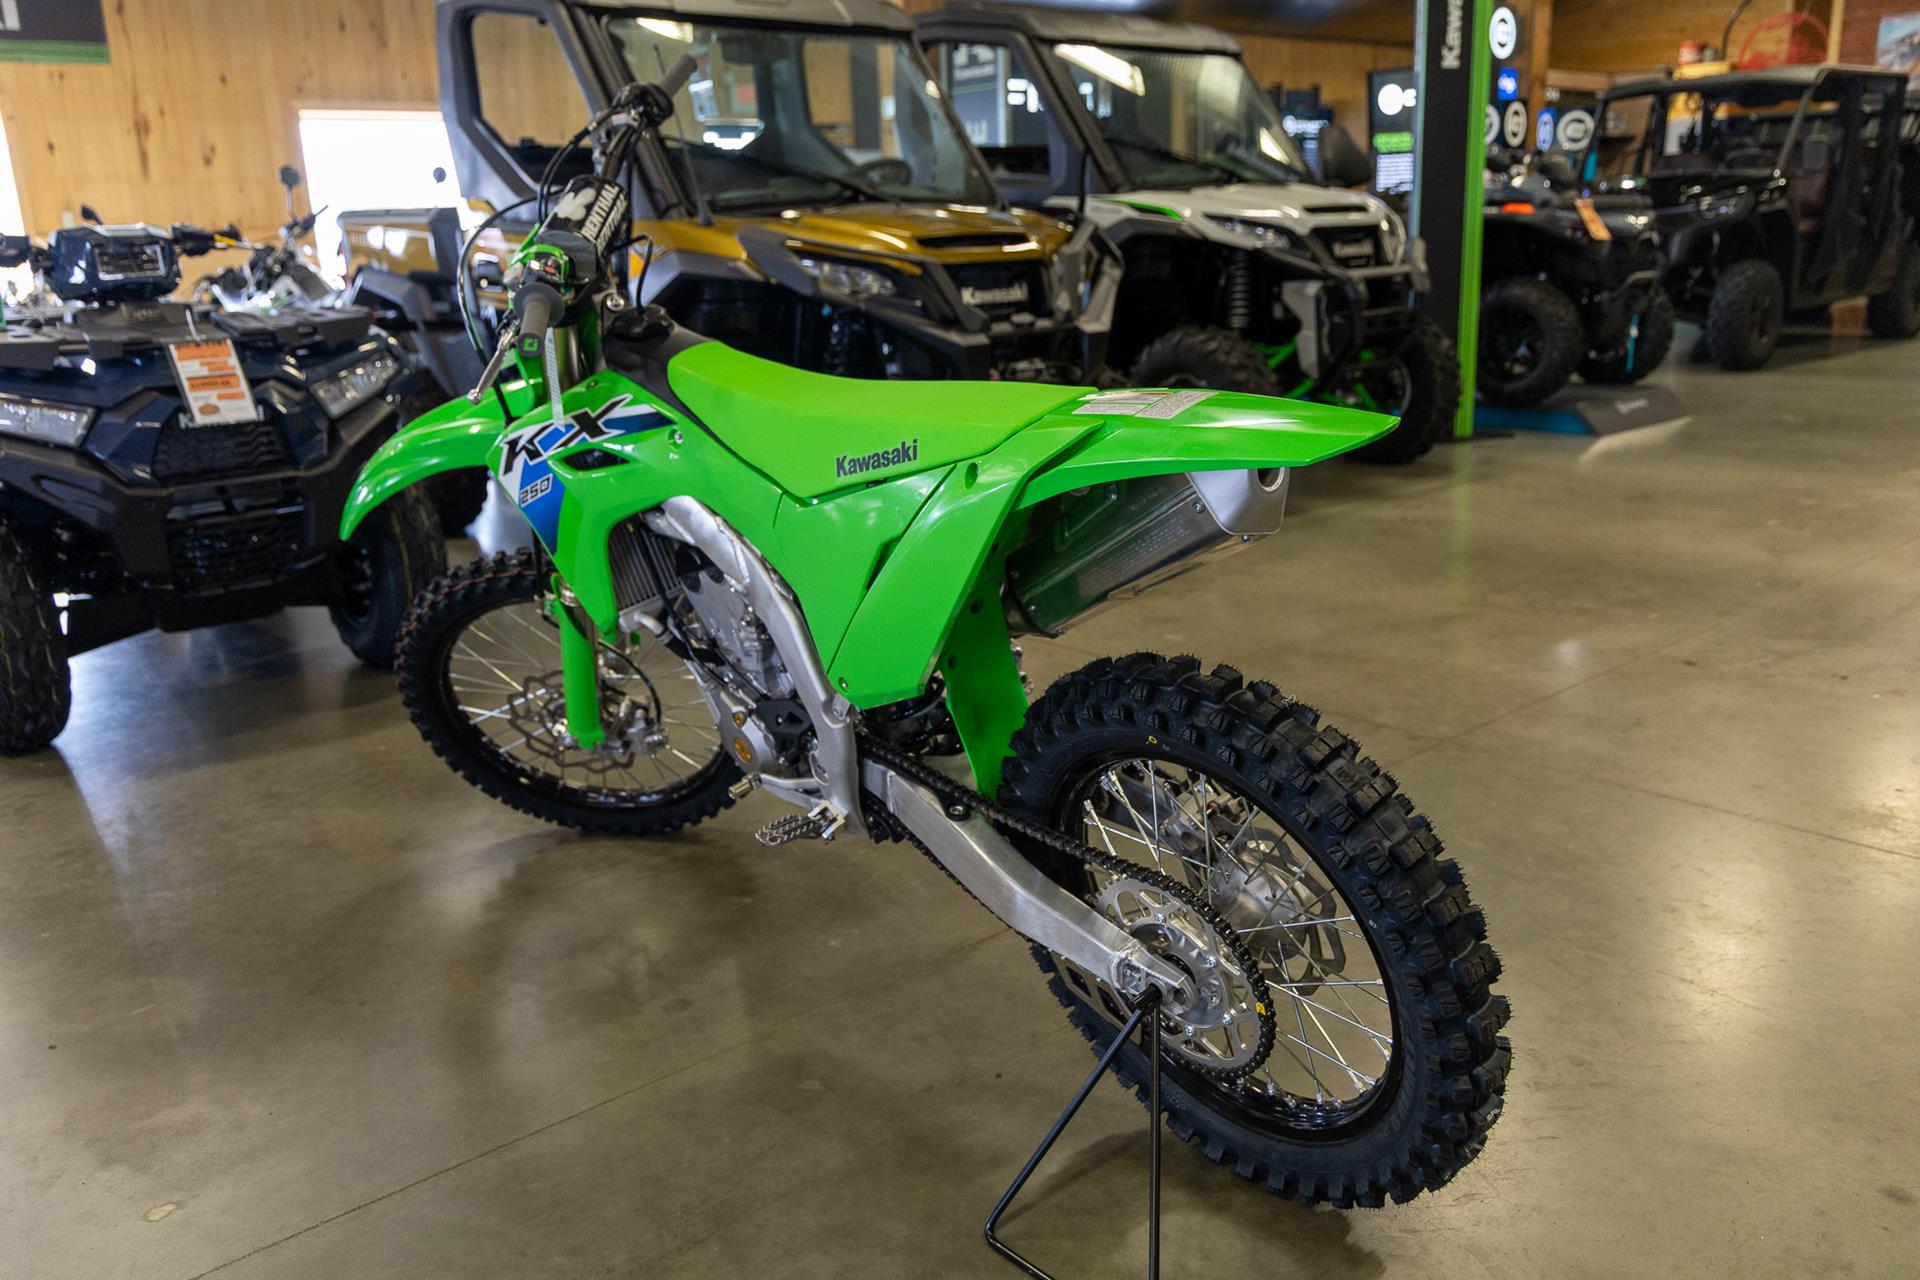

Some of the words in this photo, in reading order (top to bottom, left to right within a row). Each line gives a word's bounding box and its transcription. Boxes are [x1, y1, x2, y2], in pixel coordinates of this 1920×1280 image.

[579, 182, 620, 245] RENTHAL
[502, 393, 634, 477] KX
[836, 439, 918, 478] Kawasaki
[520, 476, 553, 504] 250
